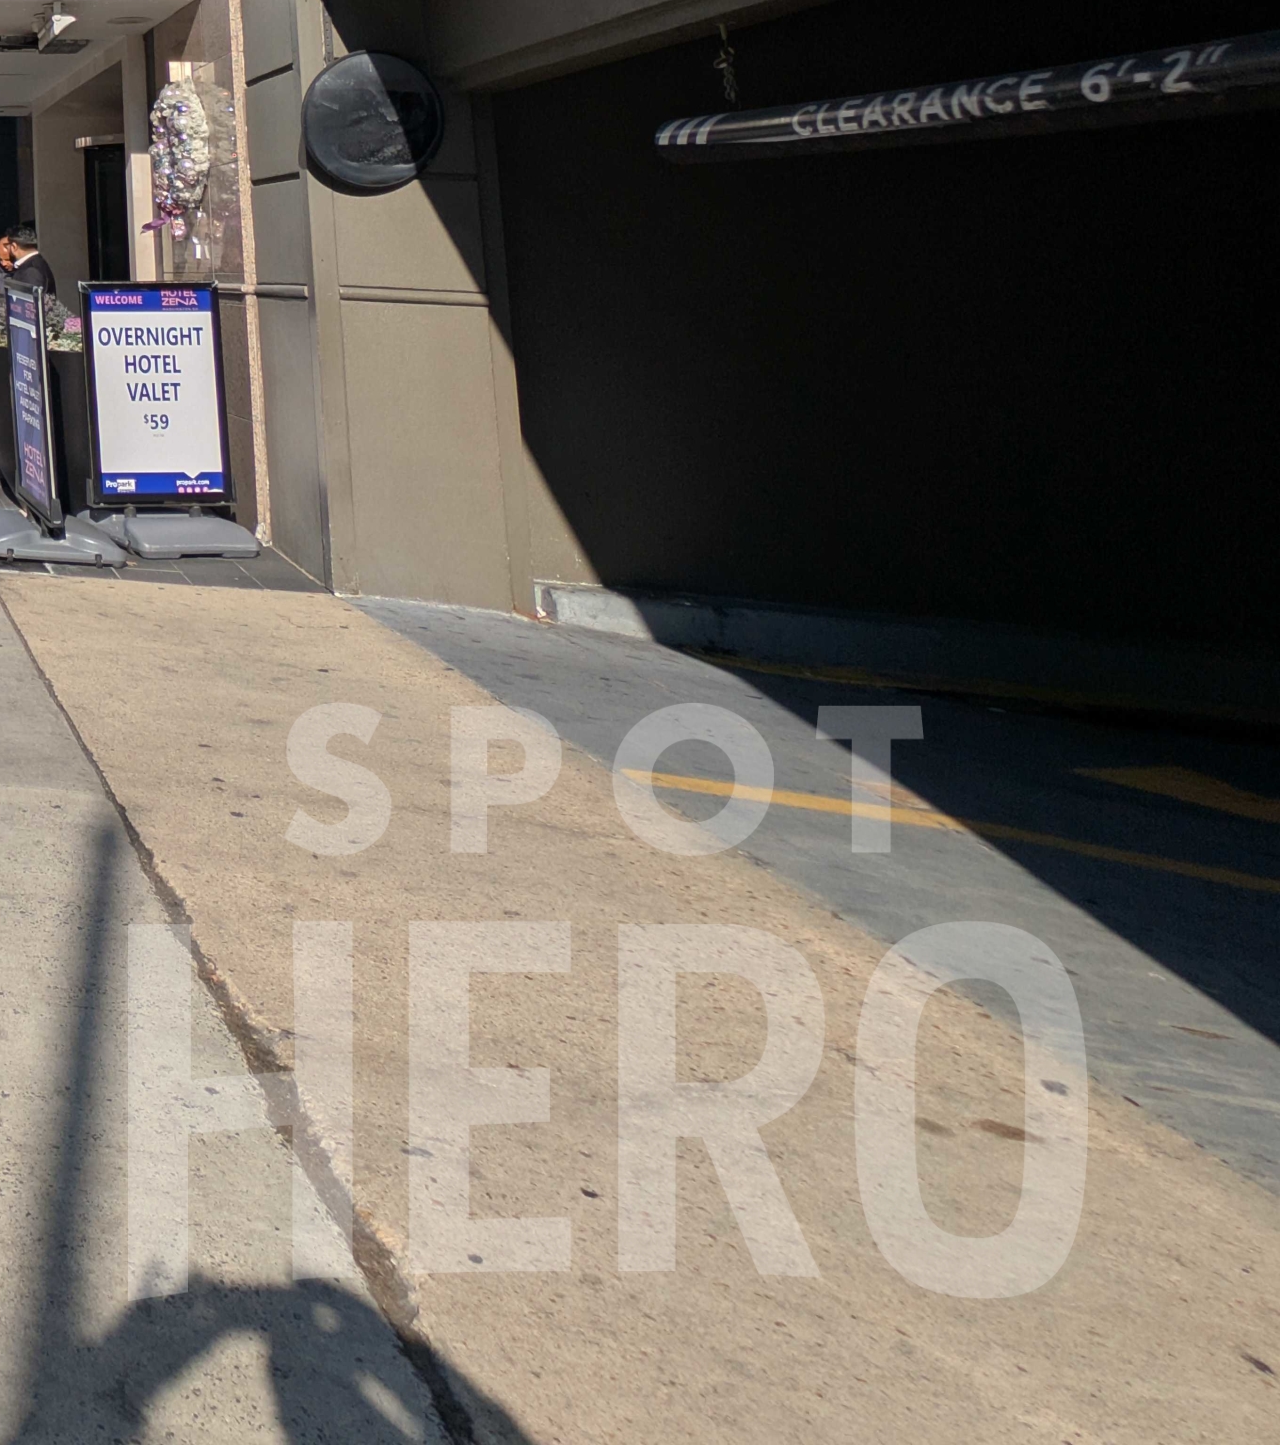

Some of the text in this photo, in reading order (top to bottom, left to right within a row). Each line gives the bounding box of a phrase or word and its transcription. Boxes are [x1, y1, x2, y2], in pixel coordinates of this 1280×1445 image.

[791, 71, 1053, 137] CLEARANCE
[95, 295, 143, 305] WELCOME
[161, 289, 197, 297] HOTEL
[161, 297, 198, 306] ZENA
[98, 327, 203, 346] OVERNIGHT
[124, 354, 182, 374] HOTEL
[126, 383, 181, 402] VALET
[143, 413, 169, 430] $59
[106, 480, 132, 489] Propark
